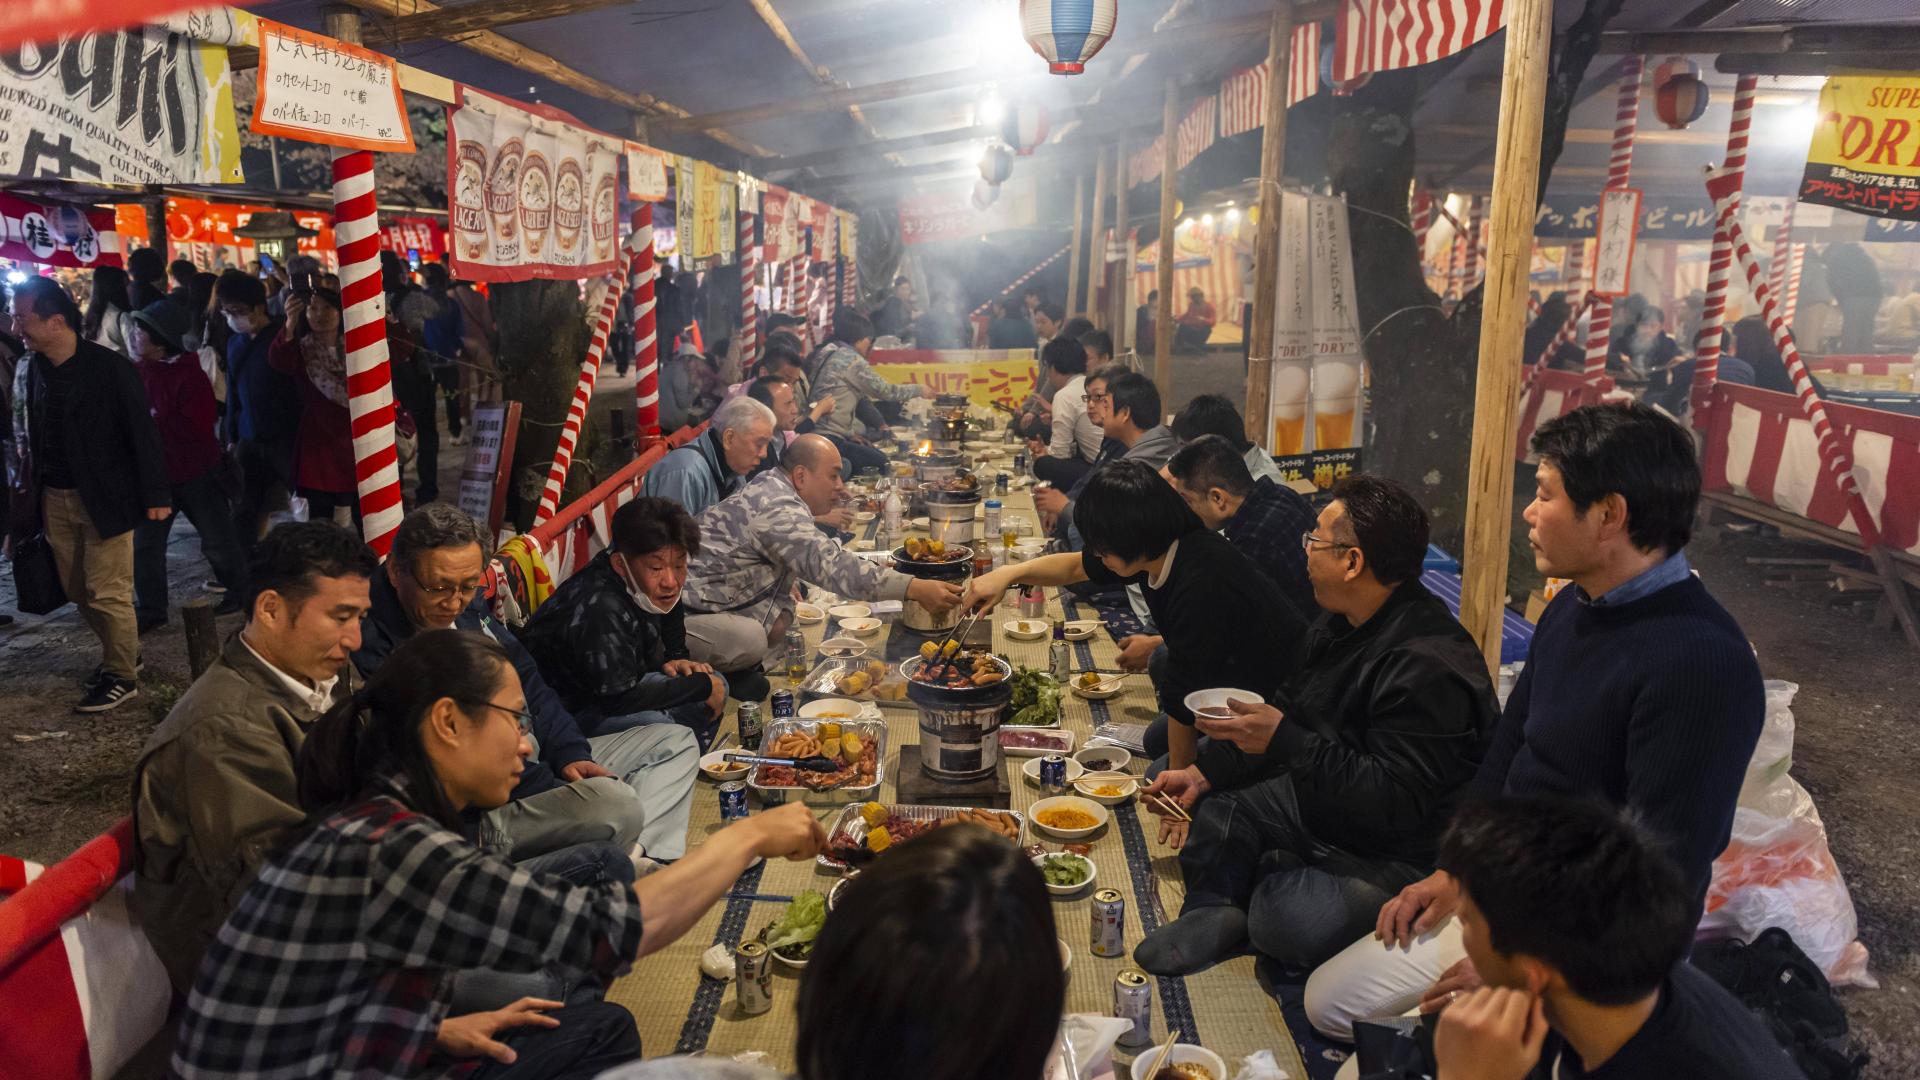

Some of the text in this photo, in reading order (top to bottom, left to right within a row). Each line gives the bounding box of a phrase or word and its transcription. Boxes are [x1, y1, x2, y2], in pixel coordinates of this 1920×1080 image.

[48, 103, 84, 130] FROM
[86, 121, 131, 155] QUALITY
[1646, 206, 1715, 229] ビール
